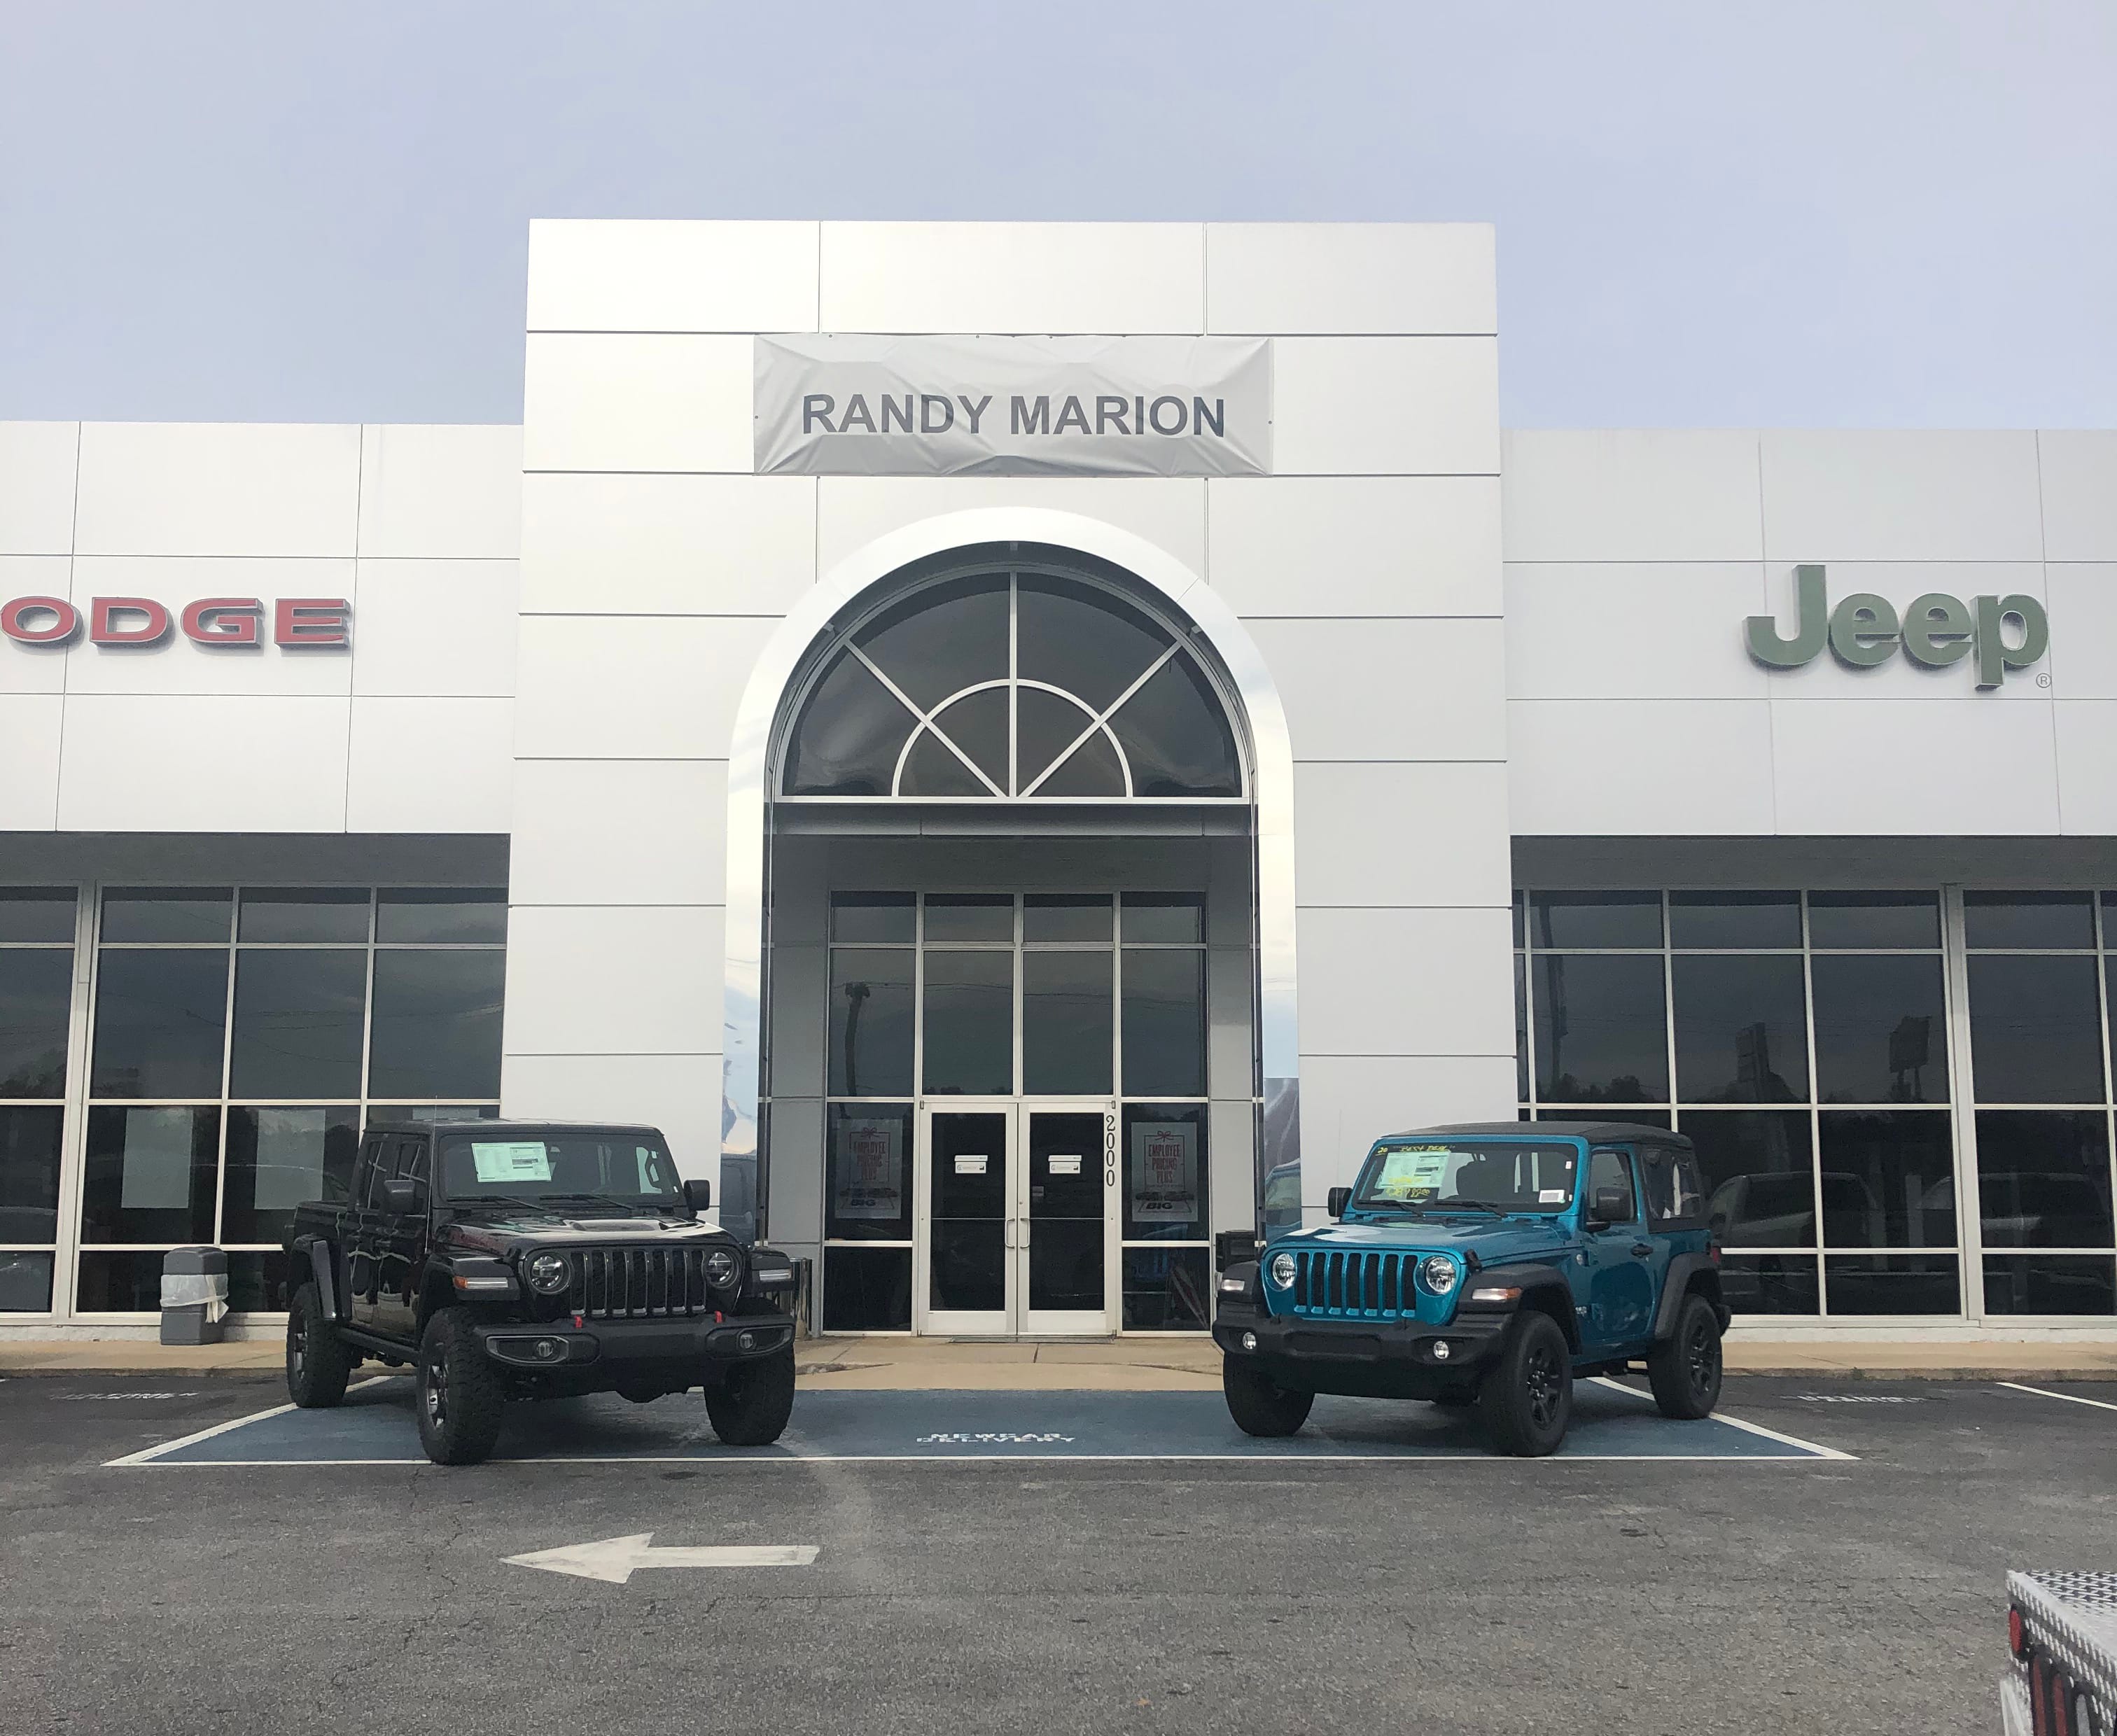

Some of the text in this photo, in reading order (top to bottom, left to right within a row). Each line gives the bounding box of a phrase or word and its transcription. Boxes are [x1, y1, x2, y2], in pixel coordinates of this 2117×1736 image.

[802, 393, 1225, 438] RANDY MARION
[1742, 565, 2049, 690] Jeep
[854, 1141, 886, 1154] EMPLOYEE
[1105, 1114, 1116, 1187] 2000
[1148, 1144, 1180, 1157] EMPLOYEE
[1152, 1157, 1178, 1170] PRICING
[1157, 1170, 1173, 1184] PLUS
[851, 1198, 876, 1207] BIG
